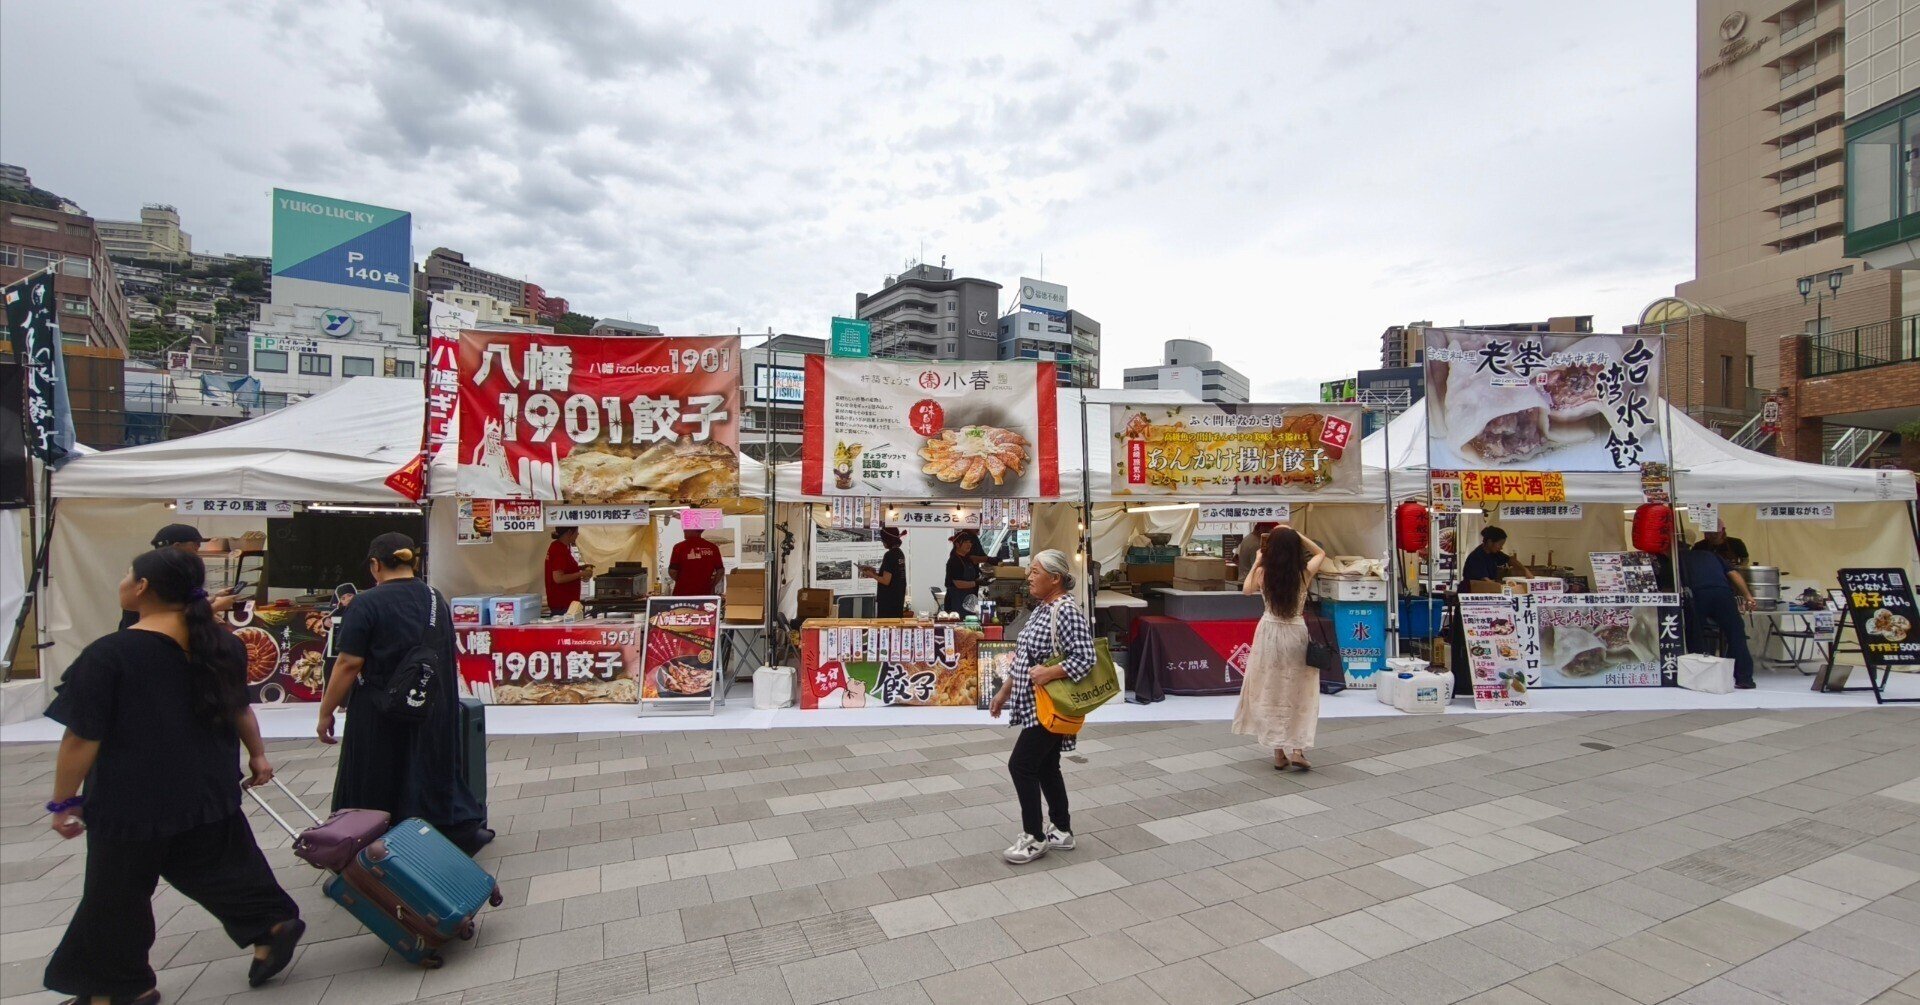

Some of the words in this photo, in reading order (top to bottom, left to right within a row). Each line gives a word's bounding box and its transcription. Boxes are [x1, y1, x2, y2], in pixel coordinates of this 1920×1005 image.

[279, 198, 323, 215] YUKO
[325, 206, 375, 223] LUCKY
[348, 251, 364, 262] P
[345, 266, 400, 284] 140台
[472, 342, 573, 392] 八幡
[589, 362, 614, 374] 八幡
[668, 348, 730, 373] 1901
[943, 370, 991, 391] 小春
[499, 393, 728, 445] 1901餃子
[1189, 413, 1284, 428] ふぐ問屋なかざき
[862, 452, 907, 460] ぎょうざソフトで
[862, 460, 888, 469] 話題の
[1148, 447, 1330, 472] あんかけ揚げ餃子
[1462, 471, 1480, 500] 冷たい
[203, 500, 267, 511] 餃子の馬渡
[558, 508, 631, 521] 八幡1901肉餃子
[1209, 507, 1274, 518] ふぐ問屋なかざき
[1770, 506, 1820, 516] 酒菜屋ながれ
[503, 521, 536, 530] 500円
[681, 509, 721, 529] 餃子
[1845, 573, 1884, 581] シュウマイ
[1352, 621, 1372, 641] 氷
[492, 650, 623, 681] 1901餃子
[870, 661, 936, 705] 餃子
[1071, 679, 1113, 704] Standard
